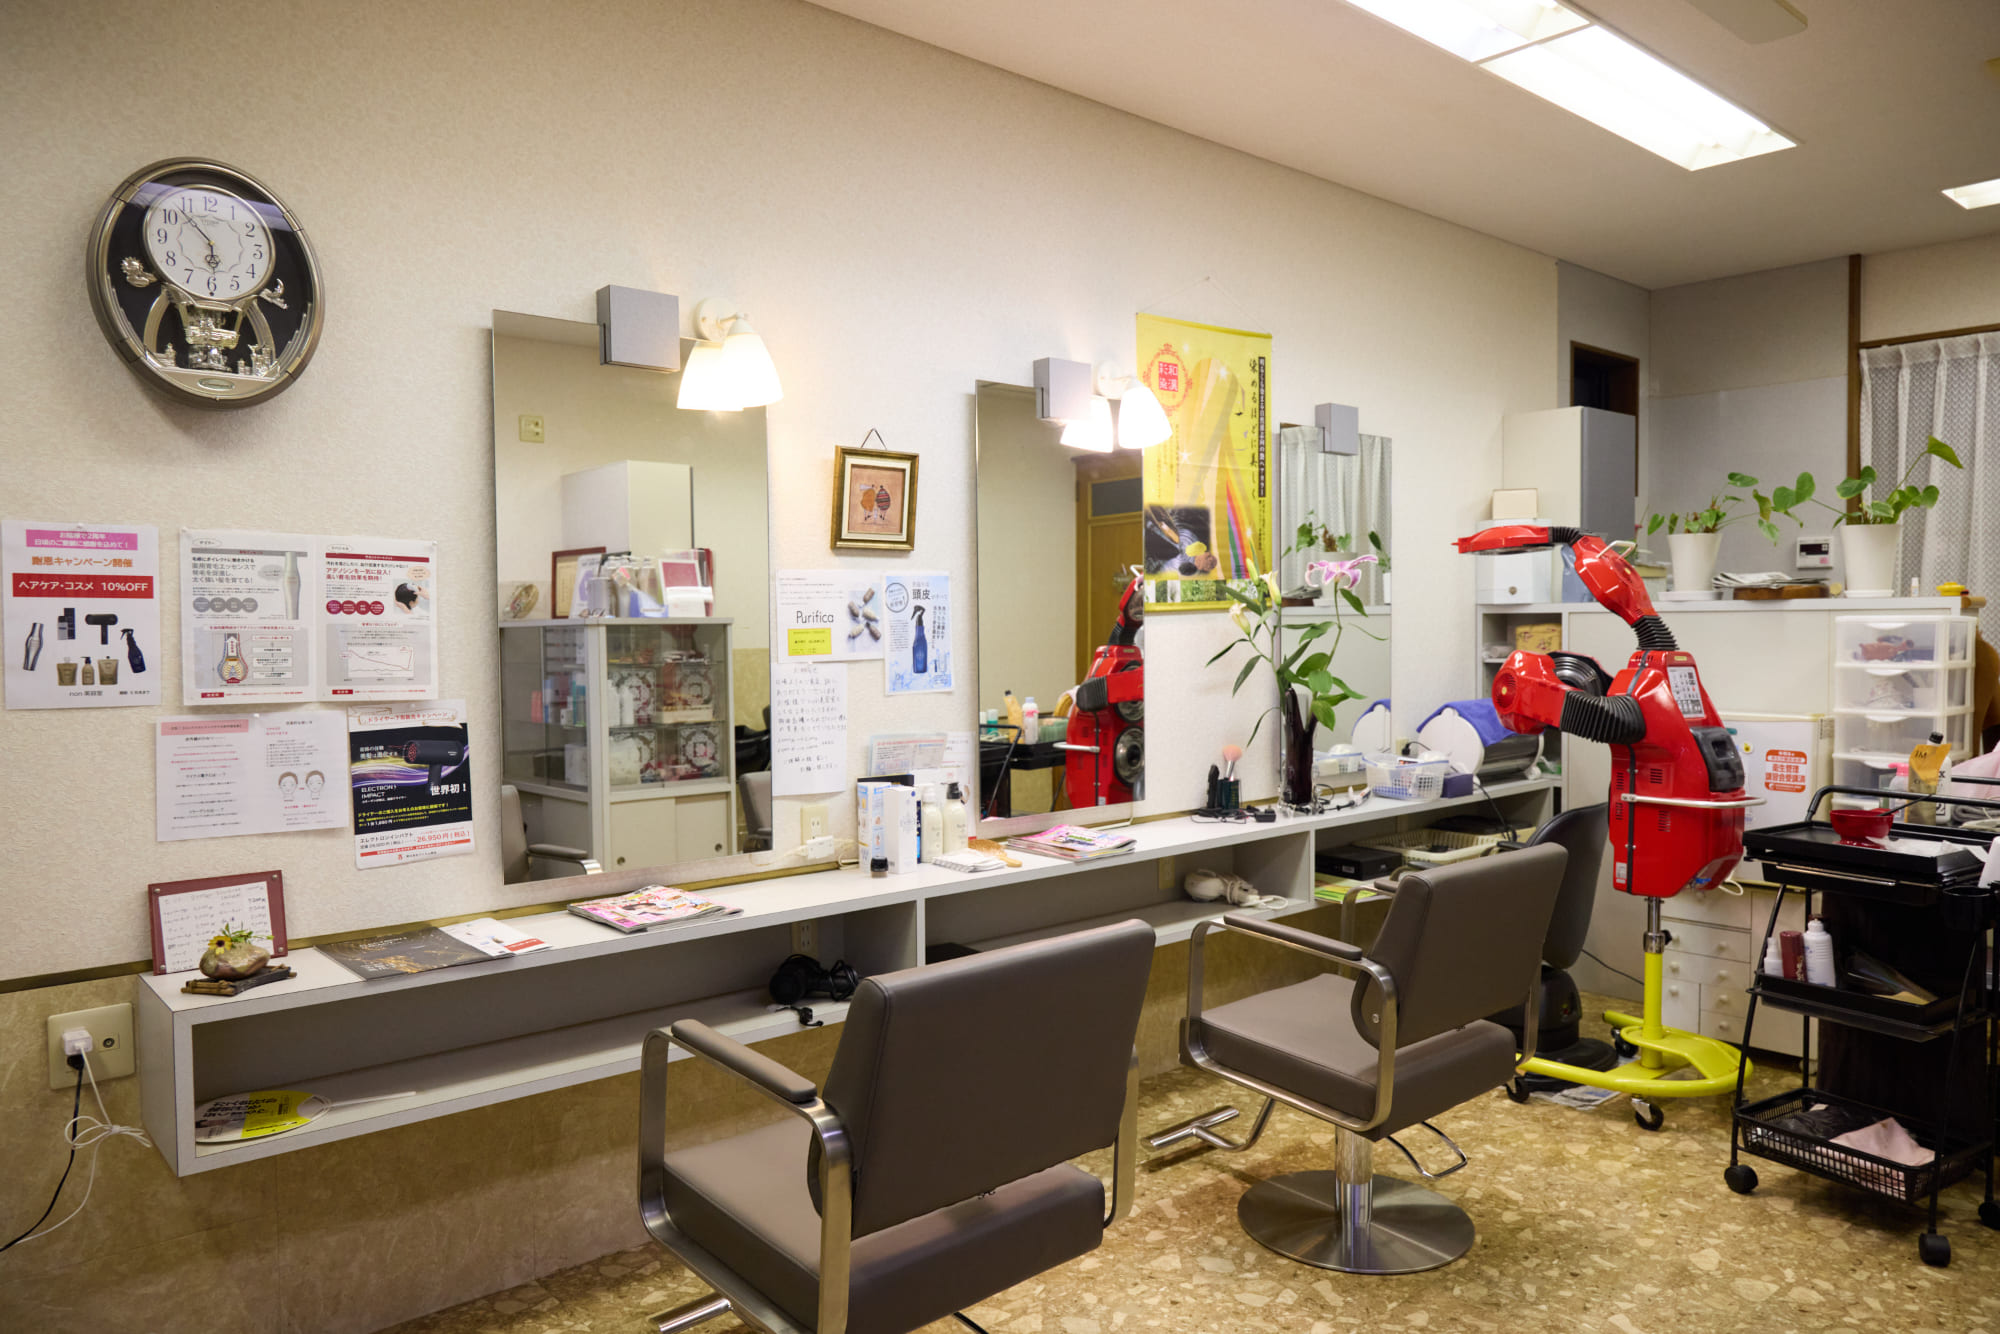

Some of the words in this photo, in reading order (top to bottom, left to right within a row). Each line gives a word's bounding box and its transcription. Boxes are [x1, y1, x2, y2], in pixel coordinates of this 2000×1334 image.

[181, 196, 193, 214] 11
[203, 196, 218, 213] 12
[230, 205, 236, 220] 1
[162, 208, 178, 226] 10
[157, 228, 168, 244] 9
[244, 222, 256, 238] 2
[165, 251, 176, 267] 8
[253, 244, 263, 260] 3
[184, 268, 194, 284] 7
[245, 263, 256, 279] 4
[207, 276, 217, 292] 6
[230, 275, 240, 291] 5
[31, 555, 133, 568] 謝恩キャンペーン開催
[18, 580, 94, 591] ヘアケア・コスメ
[101, 581, 149, 592] 10%OFF
[912, 588, 931, 600] 頭皮
[796, 610, 834, 624] Purifica
[431, 783, 467, 796] 世界初！
